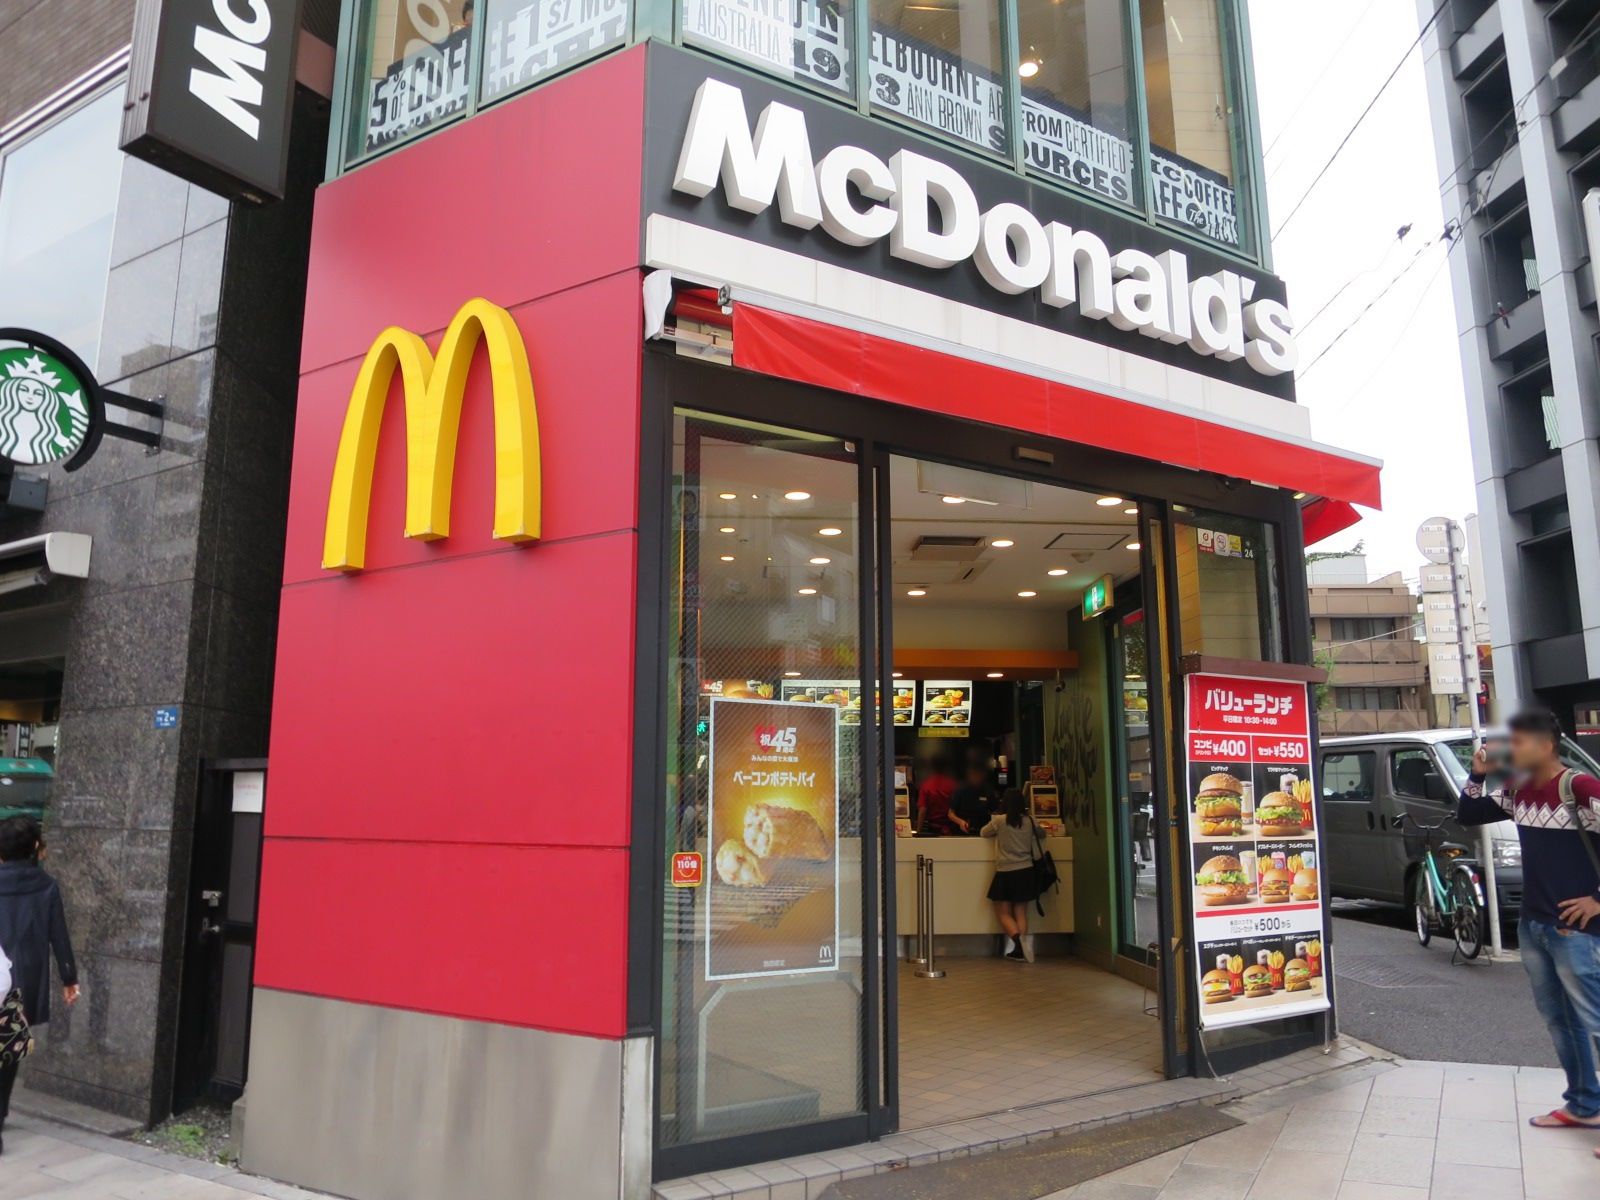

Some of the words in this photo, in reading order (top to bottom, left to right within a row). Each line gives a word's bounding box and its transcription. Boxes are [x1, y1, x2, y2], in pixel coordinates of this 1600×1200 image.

[697, 0, 781, 63] AUSTRALIA
[907, 82, 934, 123] ANN
[938, 95, 984, 144] BROWN
[1022, 109, 1063, 139] ROM
[1064, 119, 1127, 175] CERTIFIED
[672, 77, 1299, 377] McDonald's
[1245, 549, 1254, 559] 24
[1204, 688, 1293, 716] バリューランチ
[1212, 739, 1246, 757] ¥400
[1273, 742, 1304, 758] ¥550
[1254, 917, 1281, 932] ¥500
